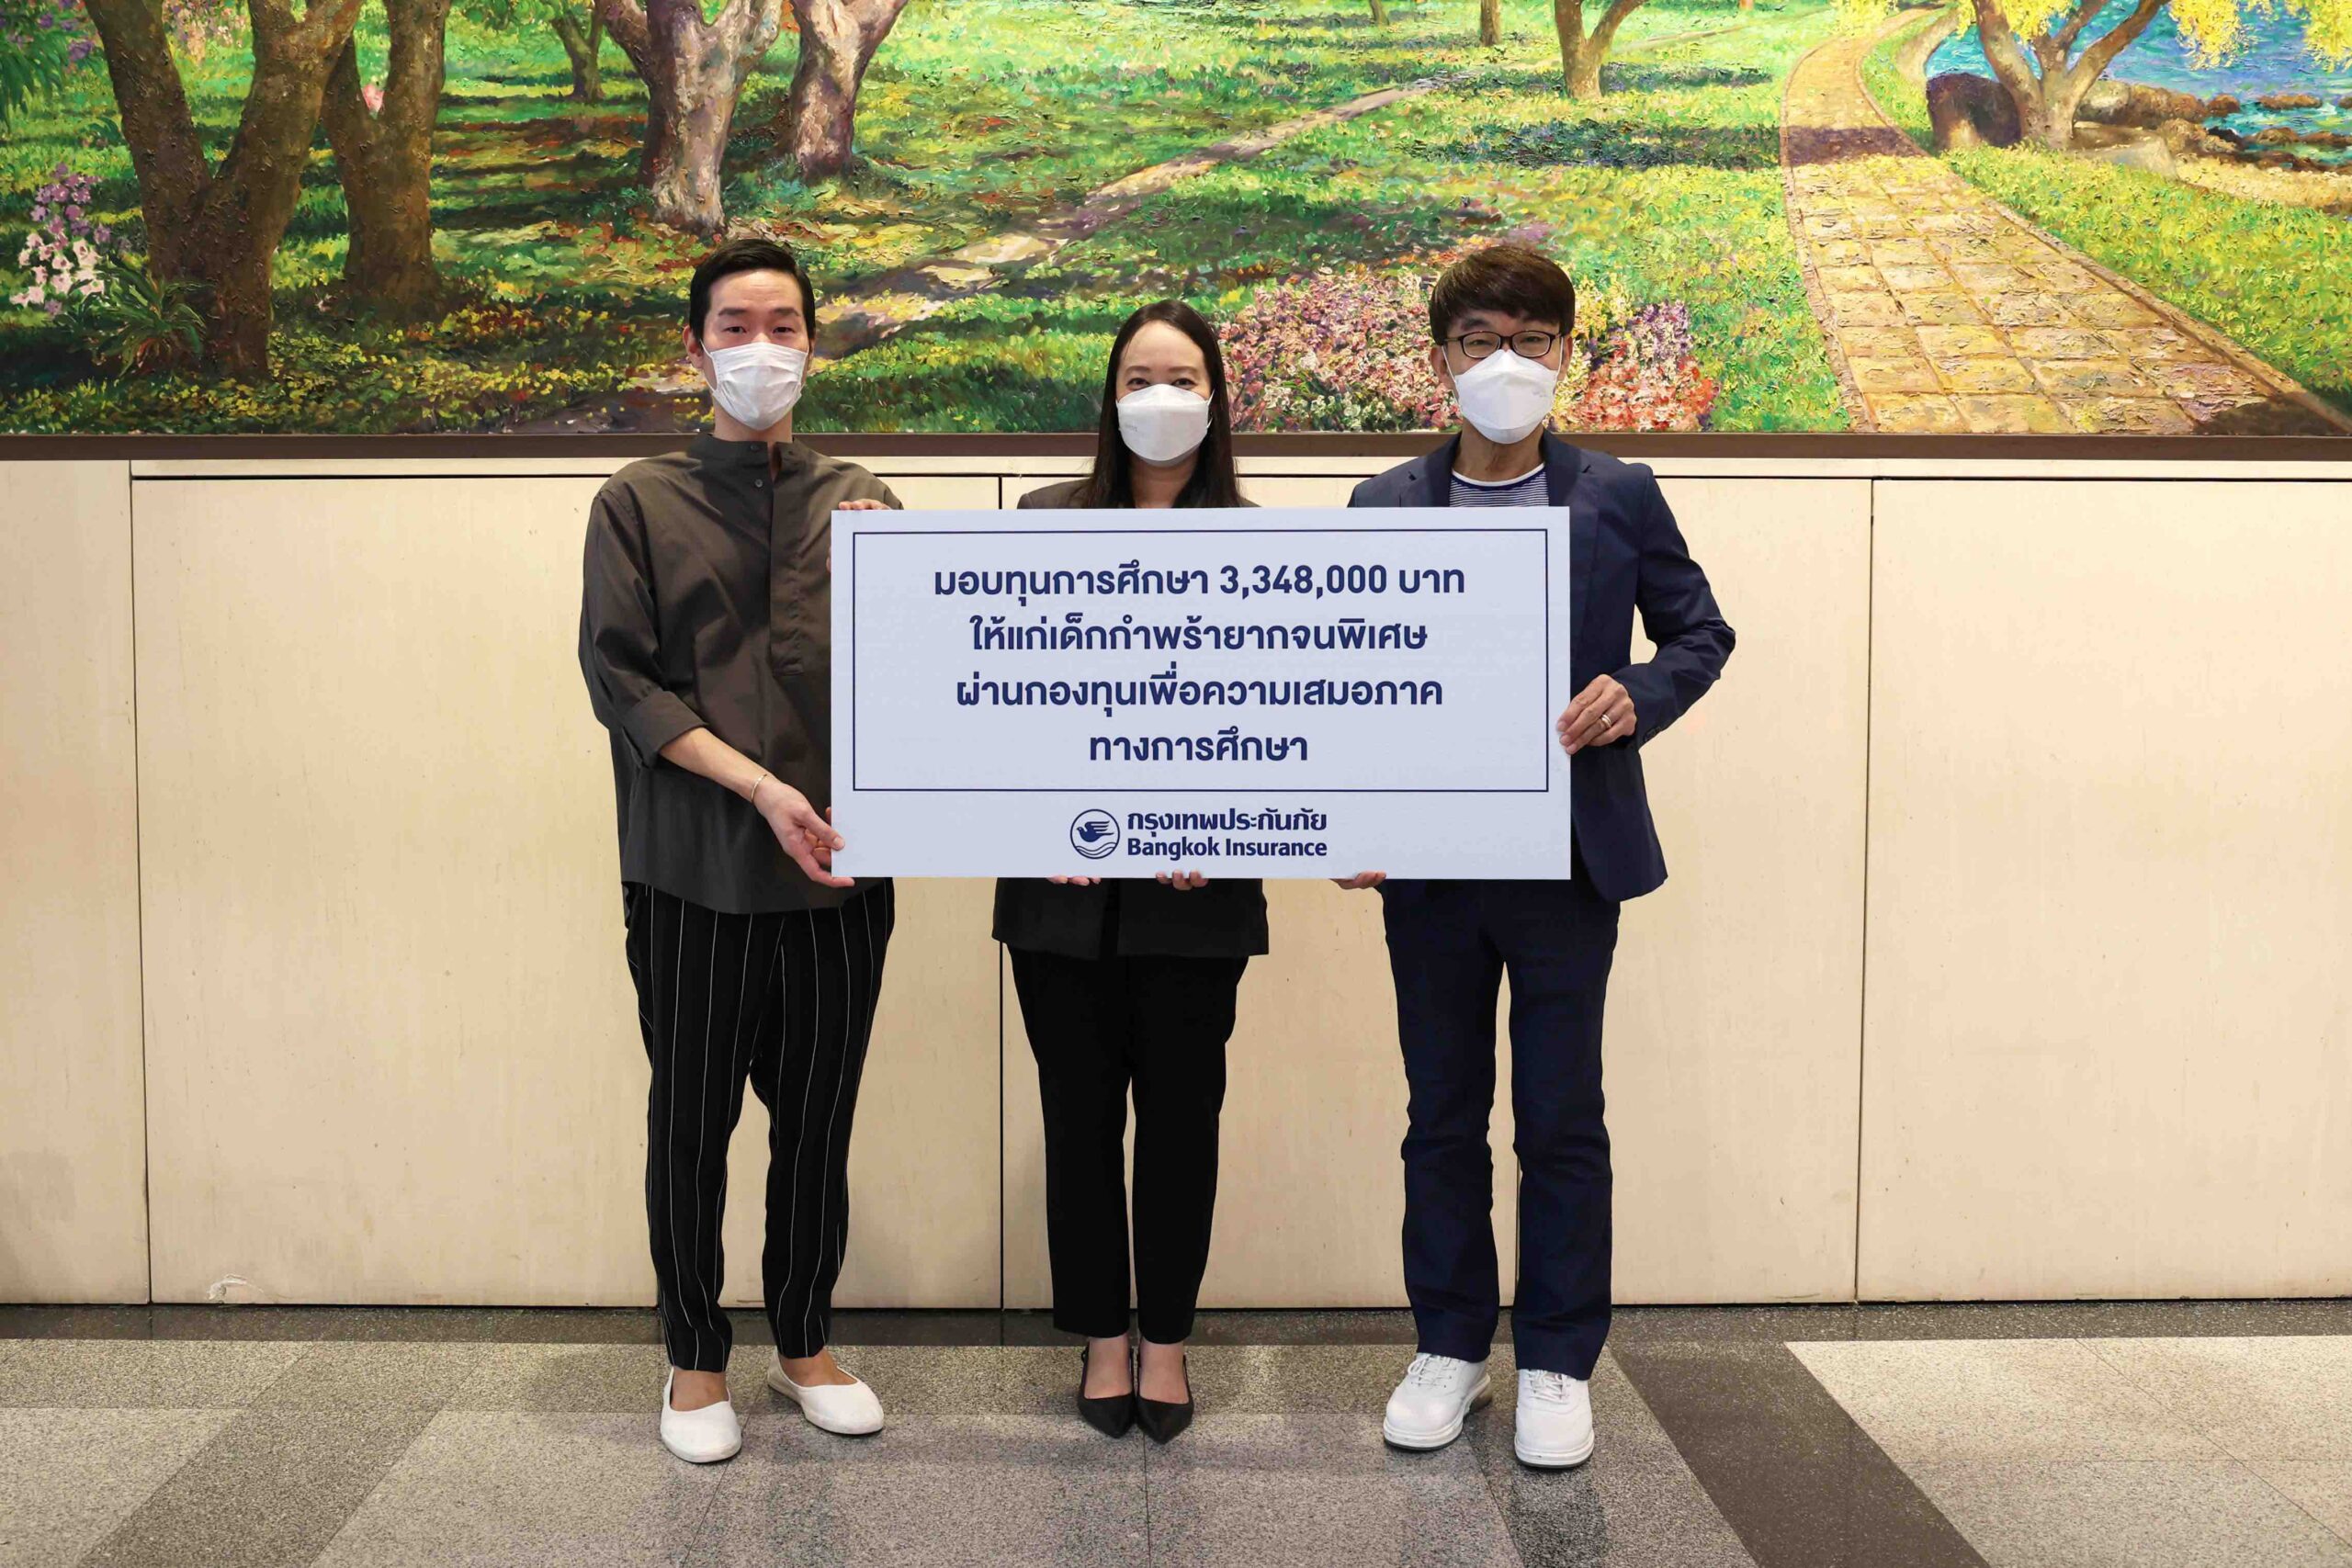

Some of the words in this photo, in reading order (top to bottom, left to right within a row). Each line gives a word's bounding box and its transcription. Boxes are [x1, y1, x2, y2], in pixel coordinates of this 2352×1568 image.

[935, 559, 1208, 606] มอบทุนการศึกษา
[1220, 565, 1386, 599] 3,348,000
[1399, 570, 1464, 593] บาท
[969, 613, 1428, 649] ให้แก่เด็กกำพร้ายากจนพิเศษ
[957, 661, 1442, 717] ผ่านกองทุนเพื่อความเสมอภาค
[1091, 726, 1307, 761] ทางการศึกษา
[1127, 808, 1328, 837] กรุงเทพประกันภัย
[1127, 837, 1221, 861] Bangkok
[1226, 838, 1328, 856] Insurance
